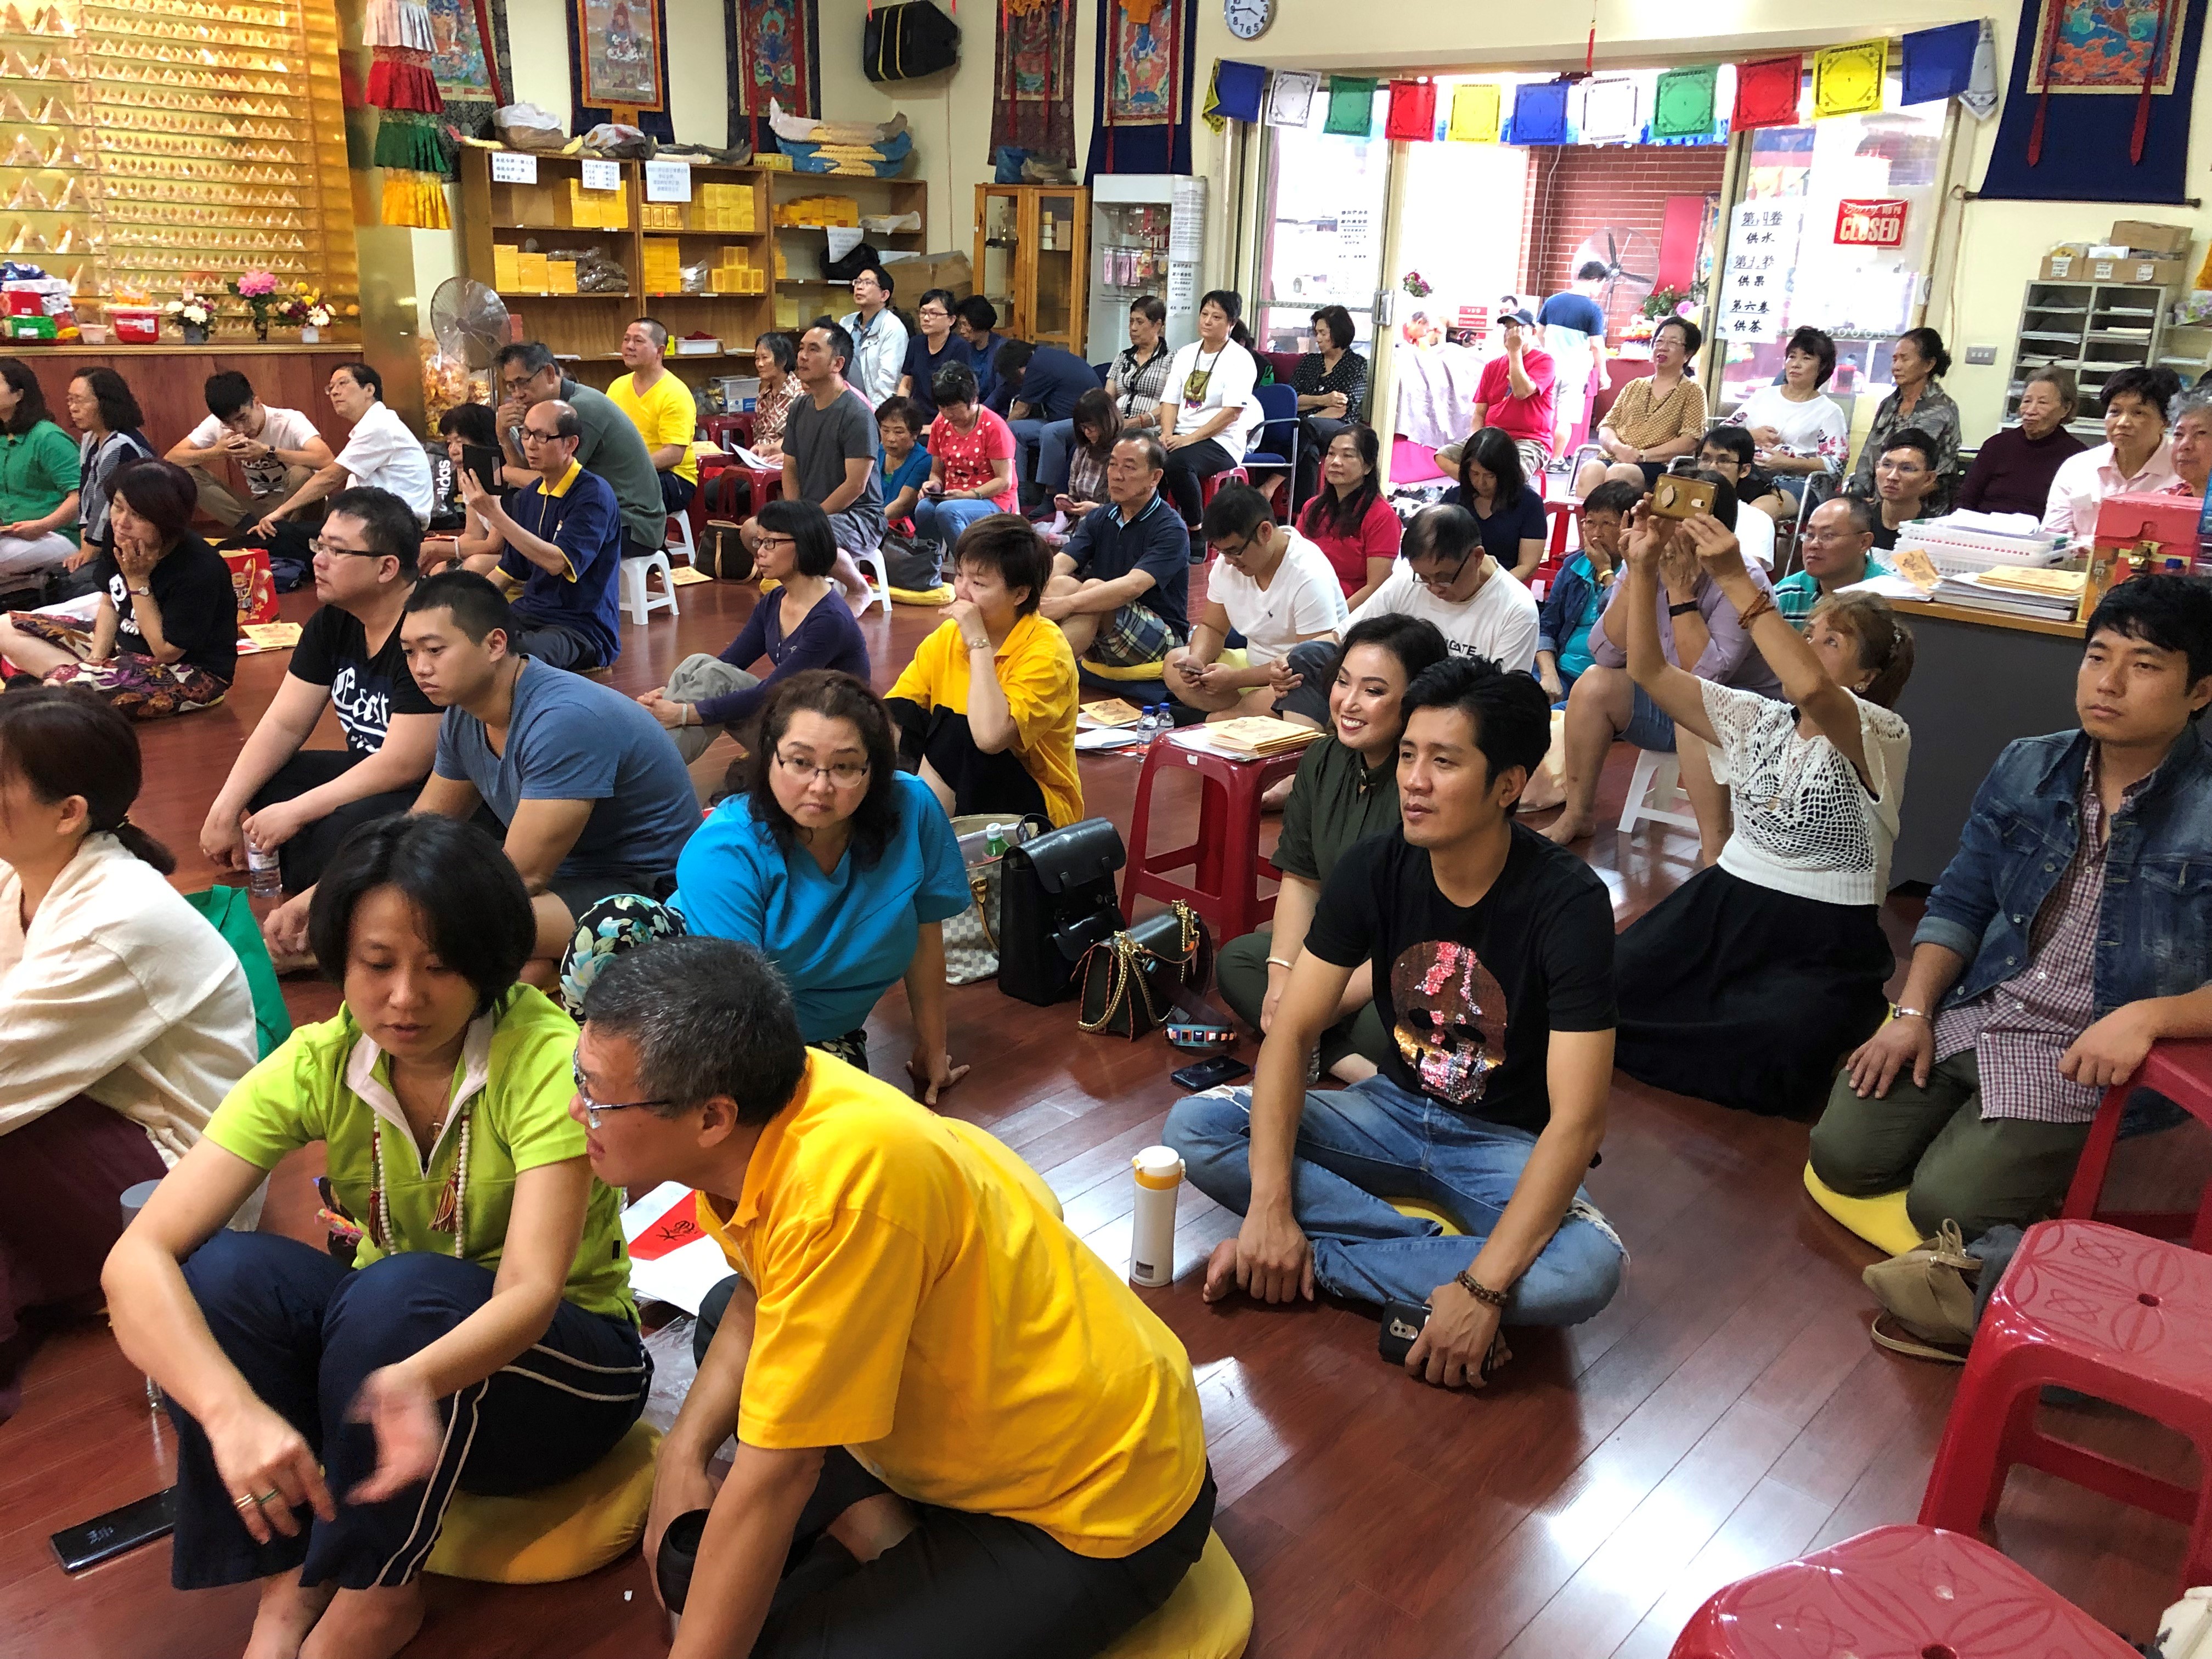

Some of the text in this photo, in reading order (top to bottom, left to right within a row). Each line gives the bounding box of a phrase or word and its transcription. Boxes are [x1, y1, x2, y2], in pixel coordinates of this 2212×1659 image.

[1231, 5, 1235, 14] 9
[1263, 4, 1268, 13] 3
[1233, 16, 1238, 25] 8
[1260, 15, 1265, 24] 4
[1240, 23, 1244, 32] 7
[1246, 26, 1251, 34] 6
[1254, 23, 1259, 31] 5
[1839, 216, 1900, 242] CLOSED
[1746, 232, 1775, 244] 供水
[1738, 275, 1764, 286] 供果
[1731, 299, 1770, 313] 第六卷
[1734, 319, 1762, 333] 供茶
